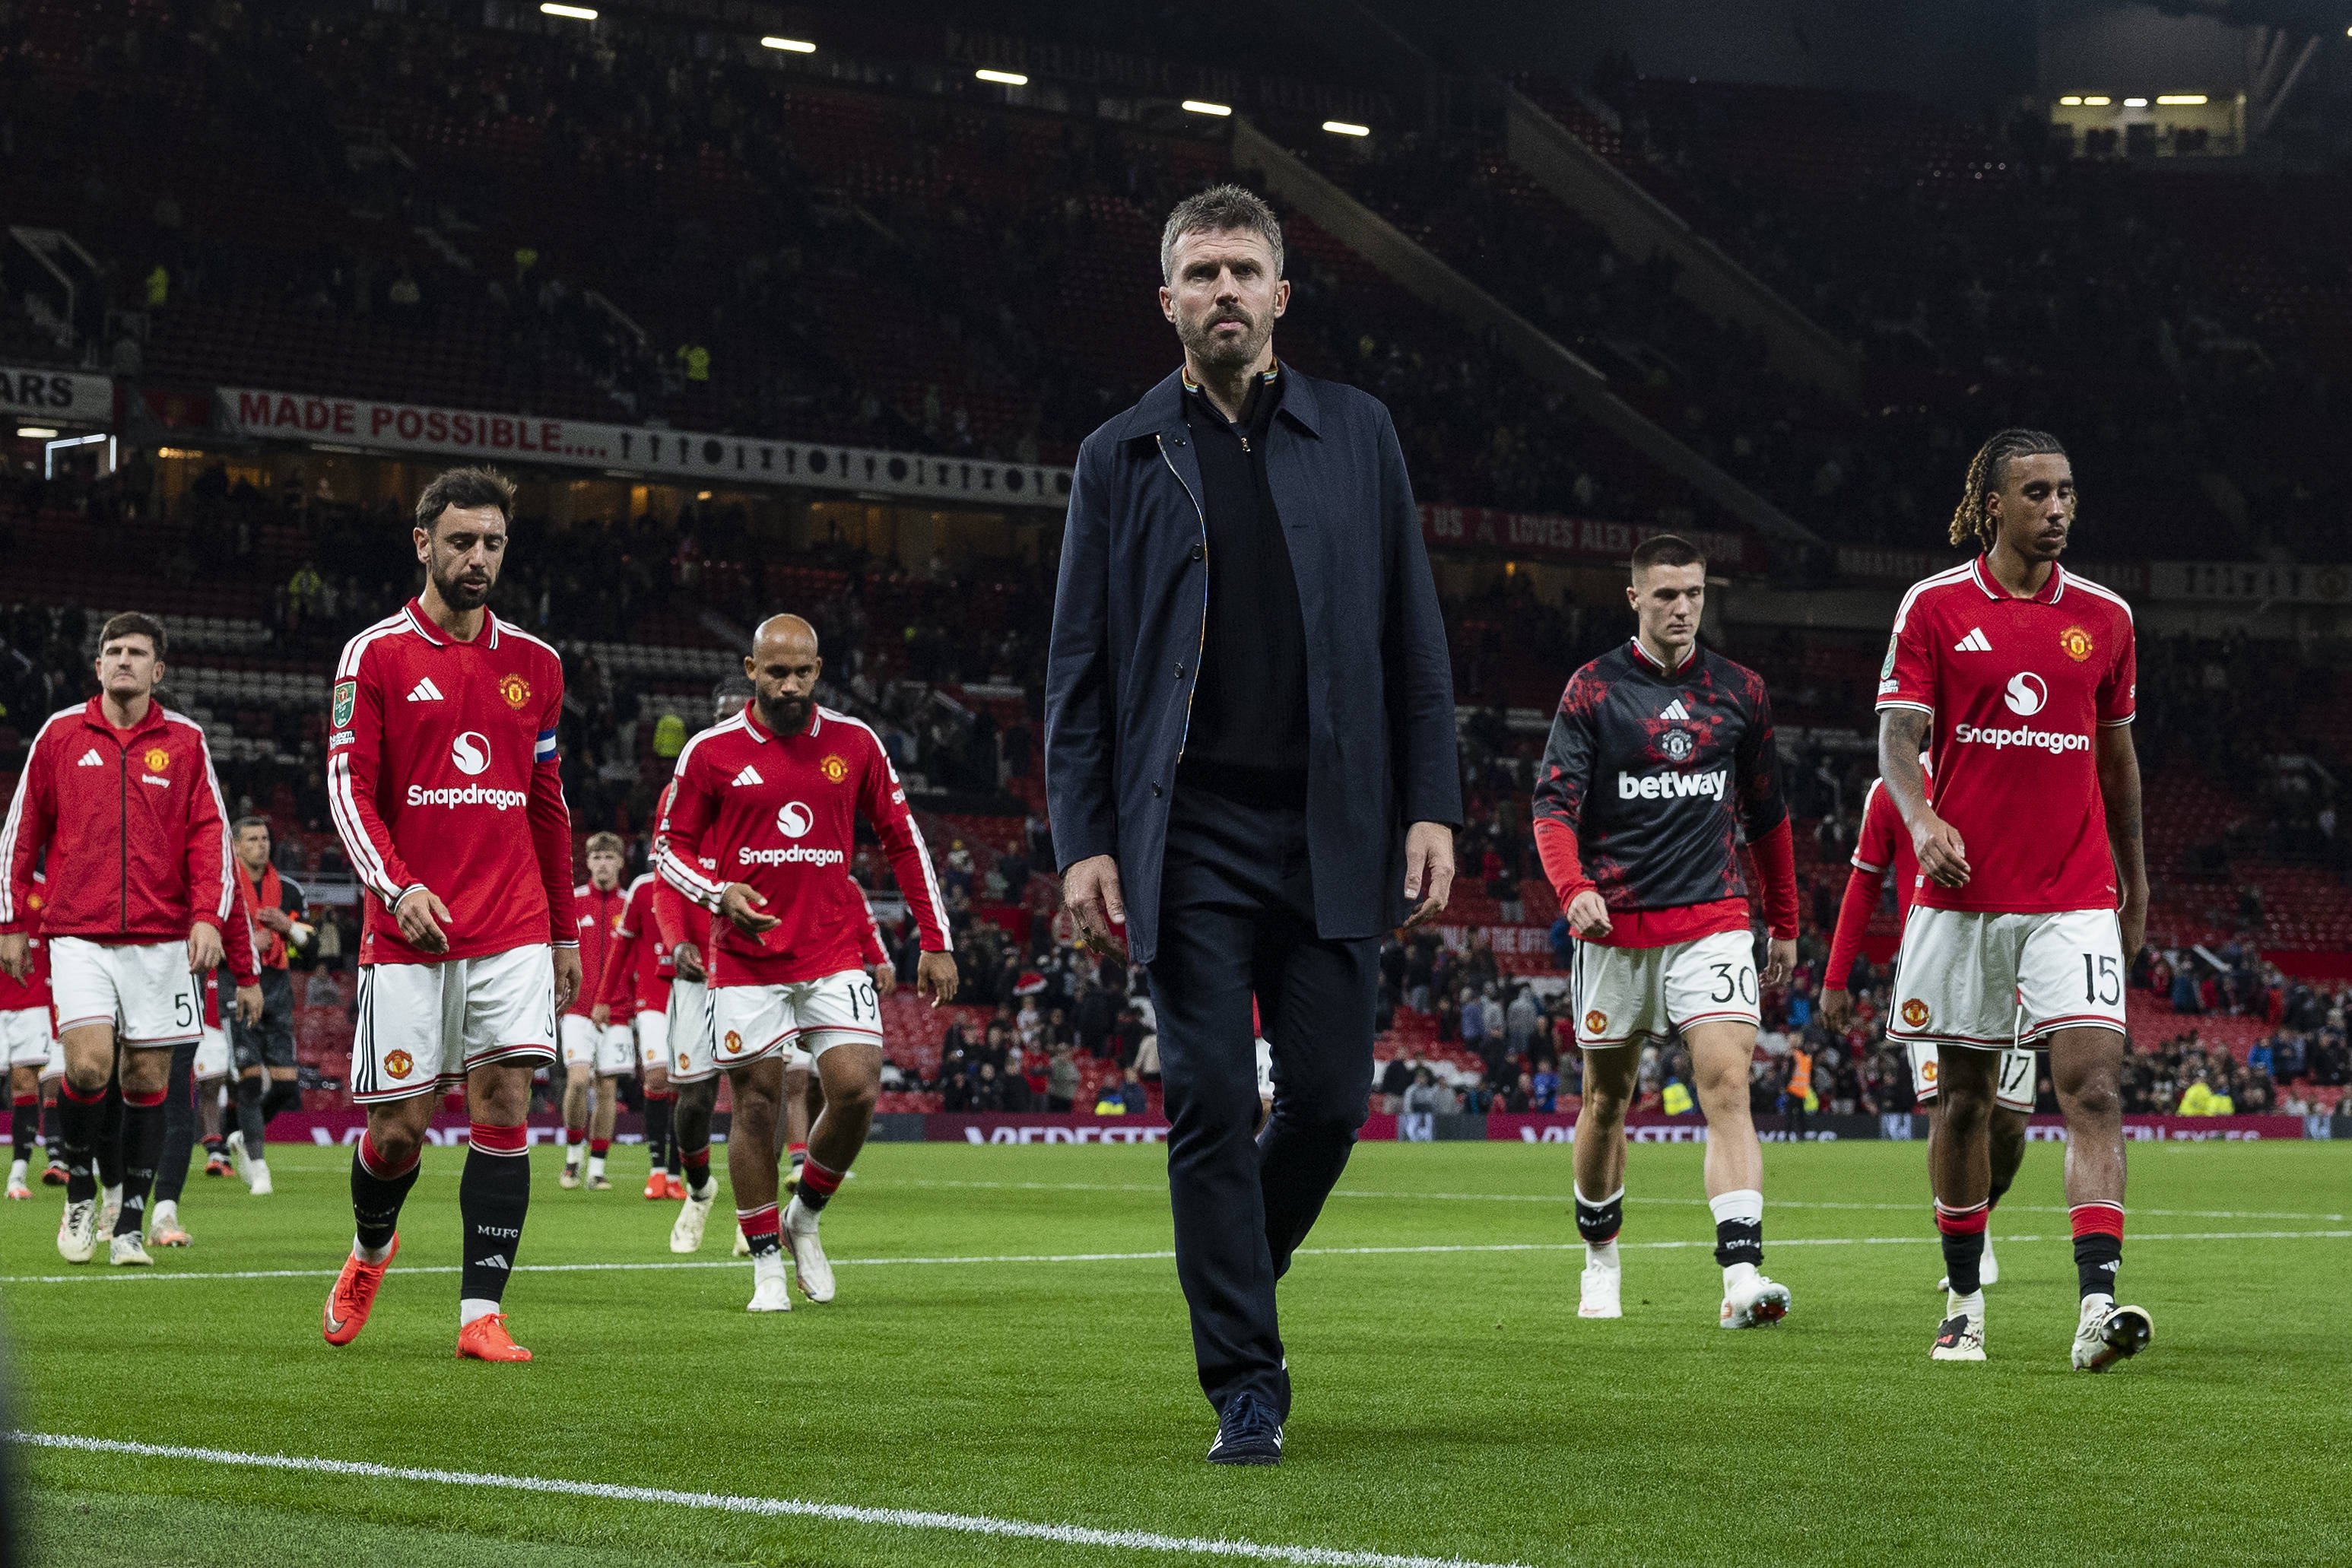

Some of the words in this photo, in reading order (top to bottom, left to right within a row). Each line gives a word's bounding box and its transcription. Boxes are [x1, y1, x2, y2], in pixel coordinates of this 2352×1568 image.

[239, 392, 356, 435] MADE
[1509, 513, 1573, 548] LOVES
[1955, 723, 2090, 754] Snapdragon
[406, 782, 527, 811] Snapdragon
[1618, 770, 1727, 801] betway
[738, 844, 844, 868] Snapdragon
[1709, 962, 1757, 1005] 30
[2081, 953, 2121, 1006] 15
[175, 993, 192, 1028] 5
[846, 983, 875, 1021] 19
[1999, 1053, 2031, 1093] 17
[477, 1224, 519, 1239] MUFC
